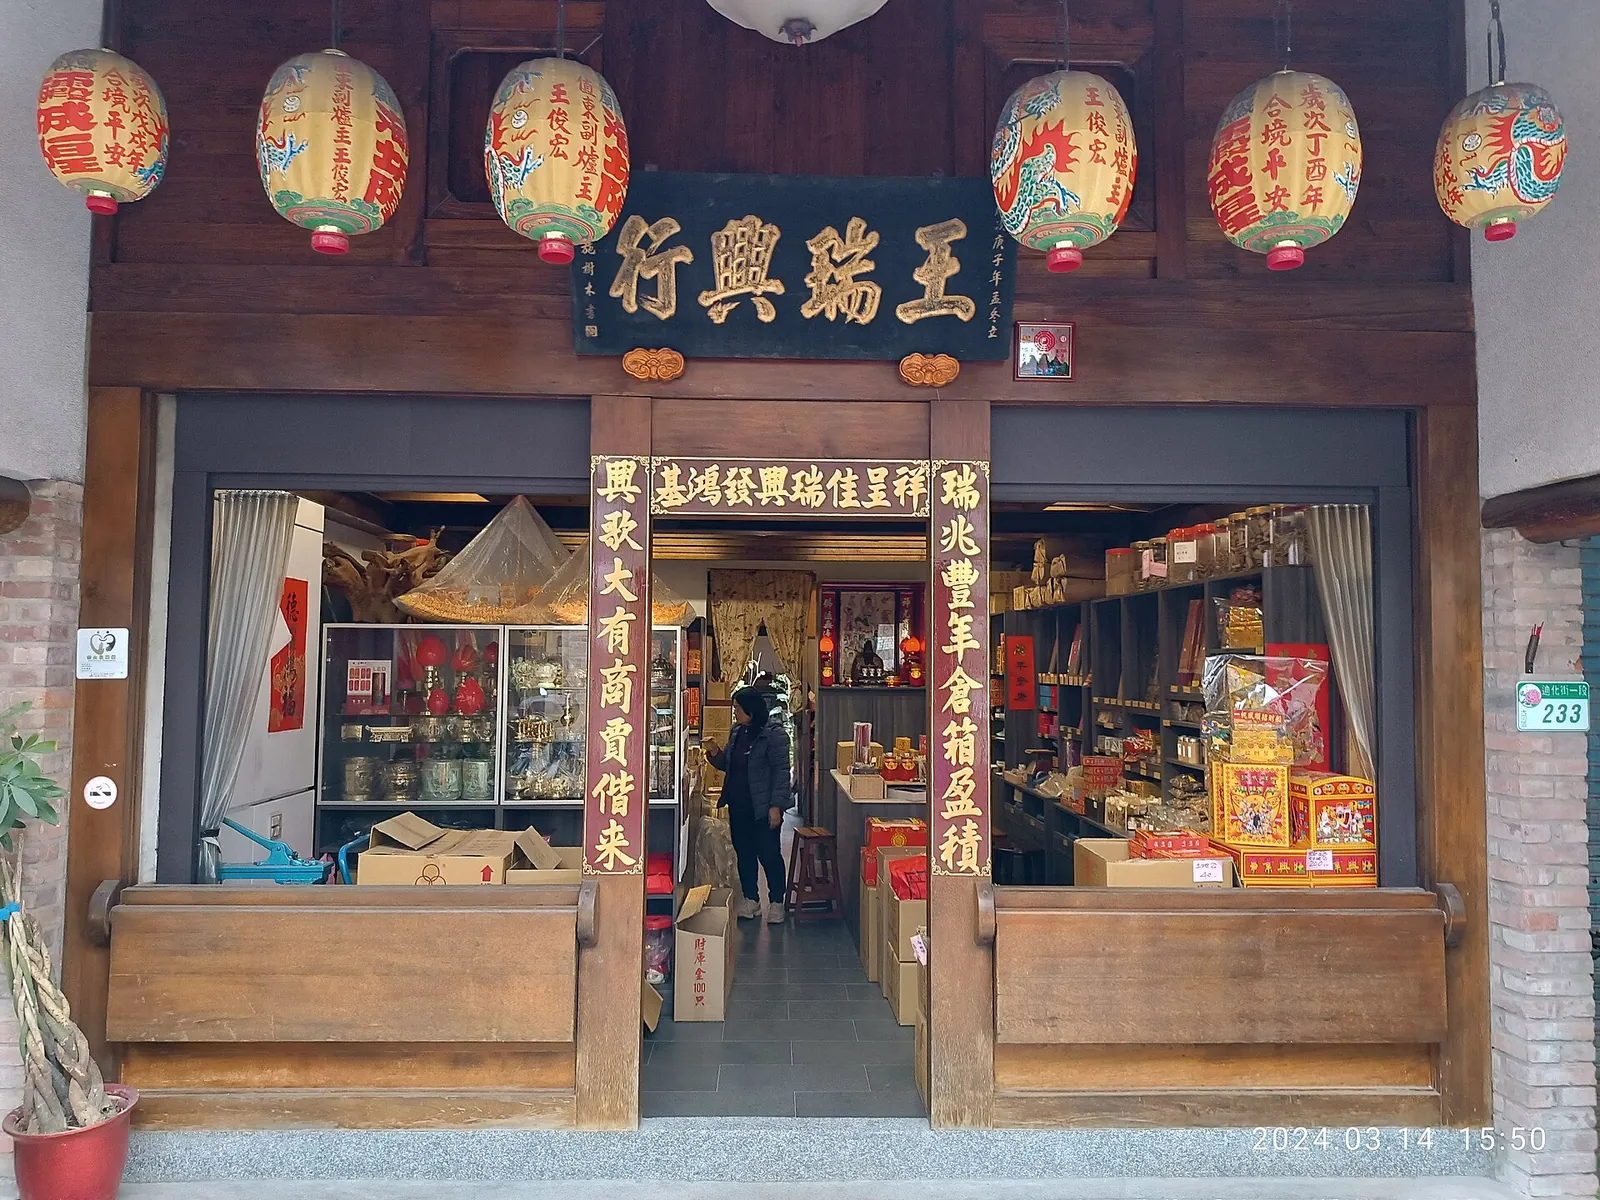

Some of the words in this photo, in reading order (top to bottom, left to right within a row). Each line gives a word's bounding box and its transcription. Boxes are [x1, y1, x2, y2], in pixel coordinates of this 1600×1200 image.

[101, 67, 131, 168] 合境平安
[546, 82, 573, 160] 王俊宏
[1084, 86, 1110, 165] 王俊宏
[1261, 92, 1292, 212] 合境平安
[1299, 82, 1331, 212] 歲次丁酉年
[608, 213, 976, 325] 王瑞興行
[655, 462, 929, 512] 祥呈佳瑞興發鴻基
[938, 463, 984, 874] 瑞兆豐年倉箱盈積
[1542, 684, 1587, 696] 迪化街一段
[1542, 703, 1581, 723] 233
